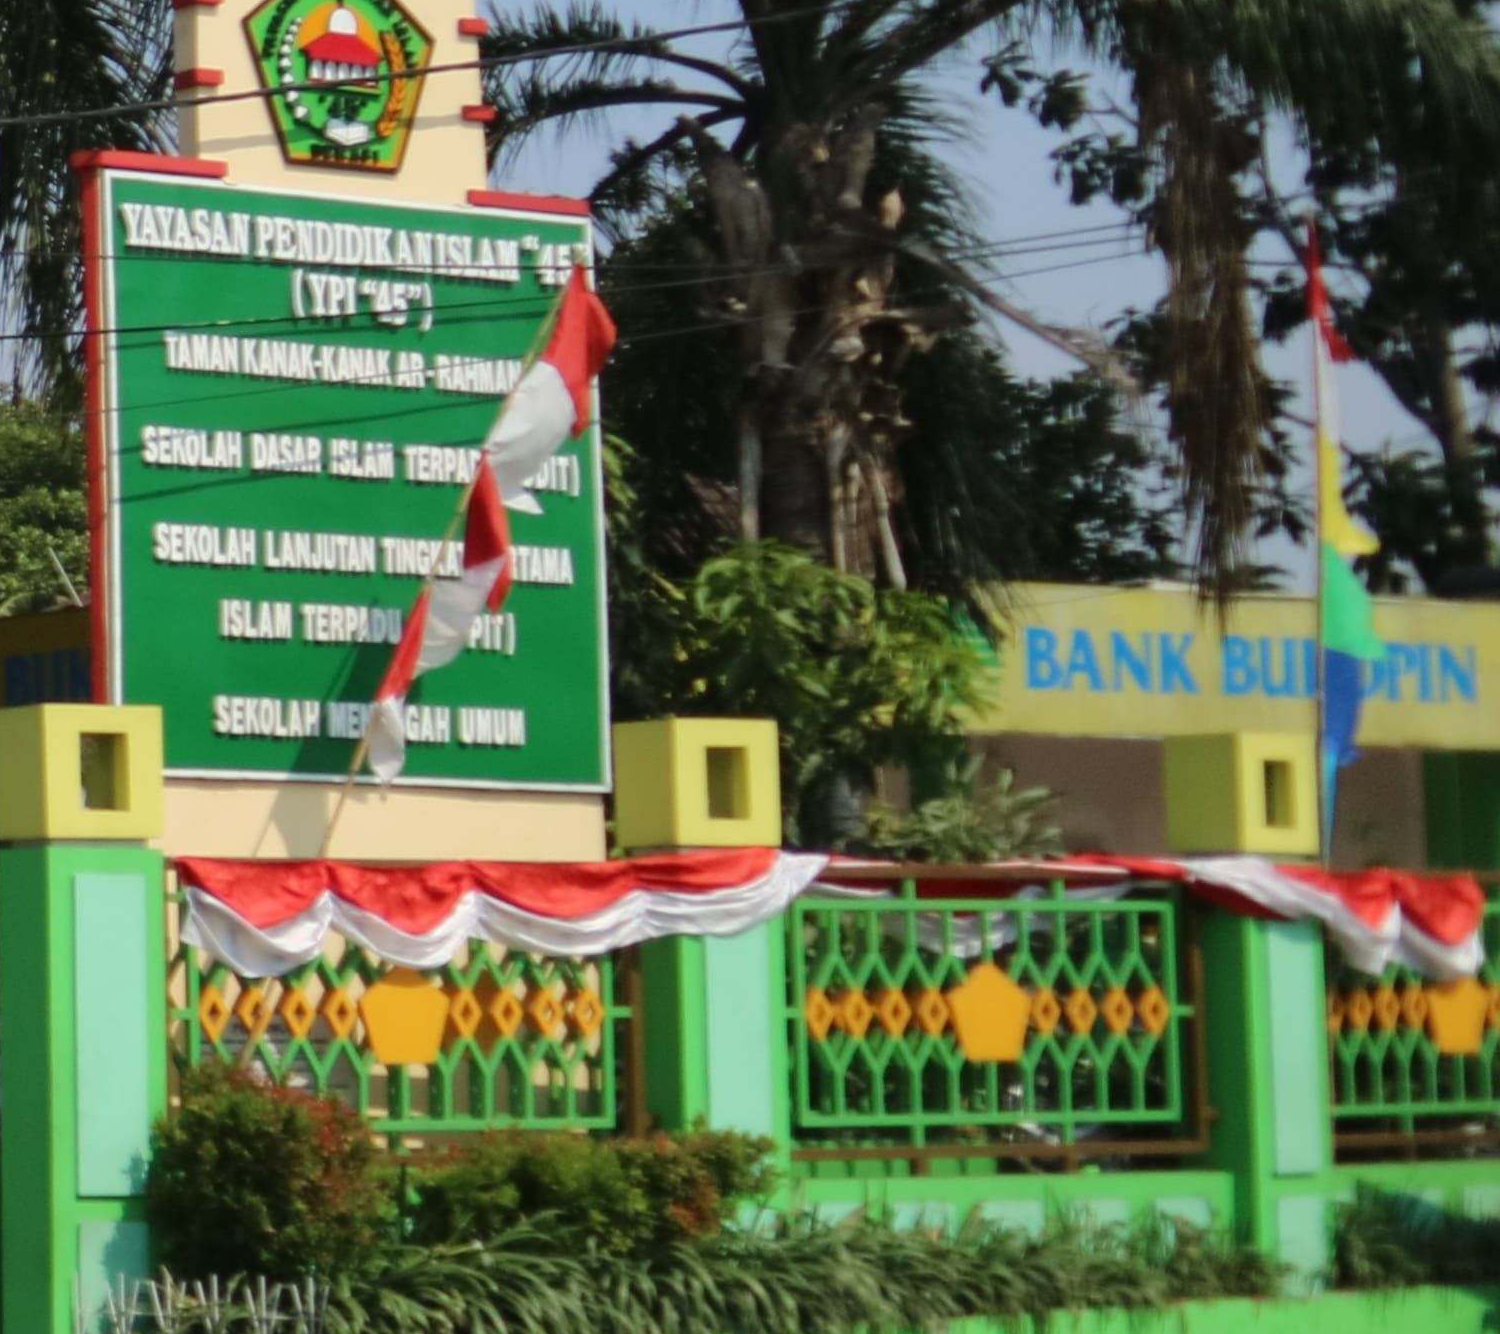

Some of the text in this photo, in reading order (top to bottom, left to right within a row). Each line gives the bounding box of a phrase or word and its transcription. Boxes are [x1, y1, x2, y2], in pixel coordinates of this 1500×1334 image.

[121, 203, 250, 255] YAYASAN
[253, 215, 433, 265] PENDIDIKAN
[435, 233, 519, 282] ISLAM
[164, 331, 239, 373] TAMAN
[243, 340, 388, 385] KANAK-KANAK
[141, 426, 241, 468] SEKOLAH
[252, 436, 322, 473] DASAR
[330, 441, 394, 480] ISLAM
[153, 523, 255, 566] SEKOLAH
[266, 532, 375, 573] LANJUTAN
[219, 599, 292, 640] ISLAM
[300, 604, 401, 644] TERPADU
[1025, 626, 1477, 704] BANK BUPIN
[213, 695, 320, 739] SEKOLAH
[459, 707, 526, 746] UMUM
